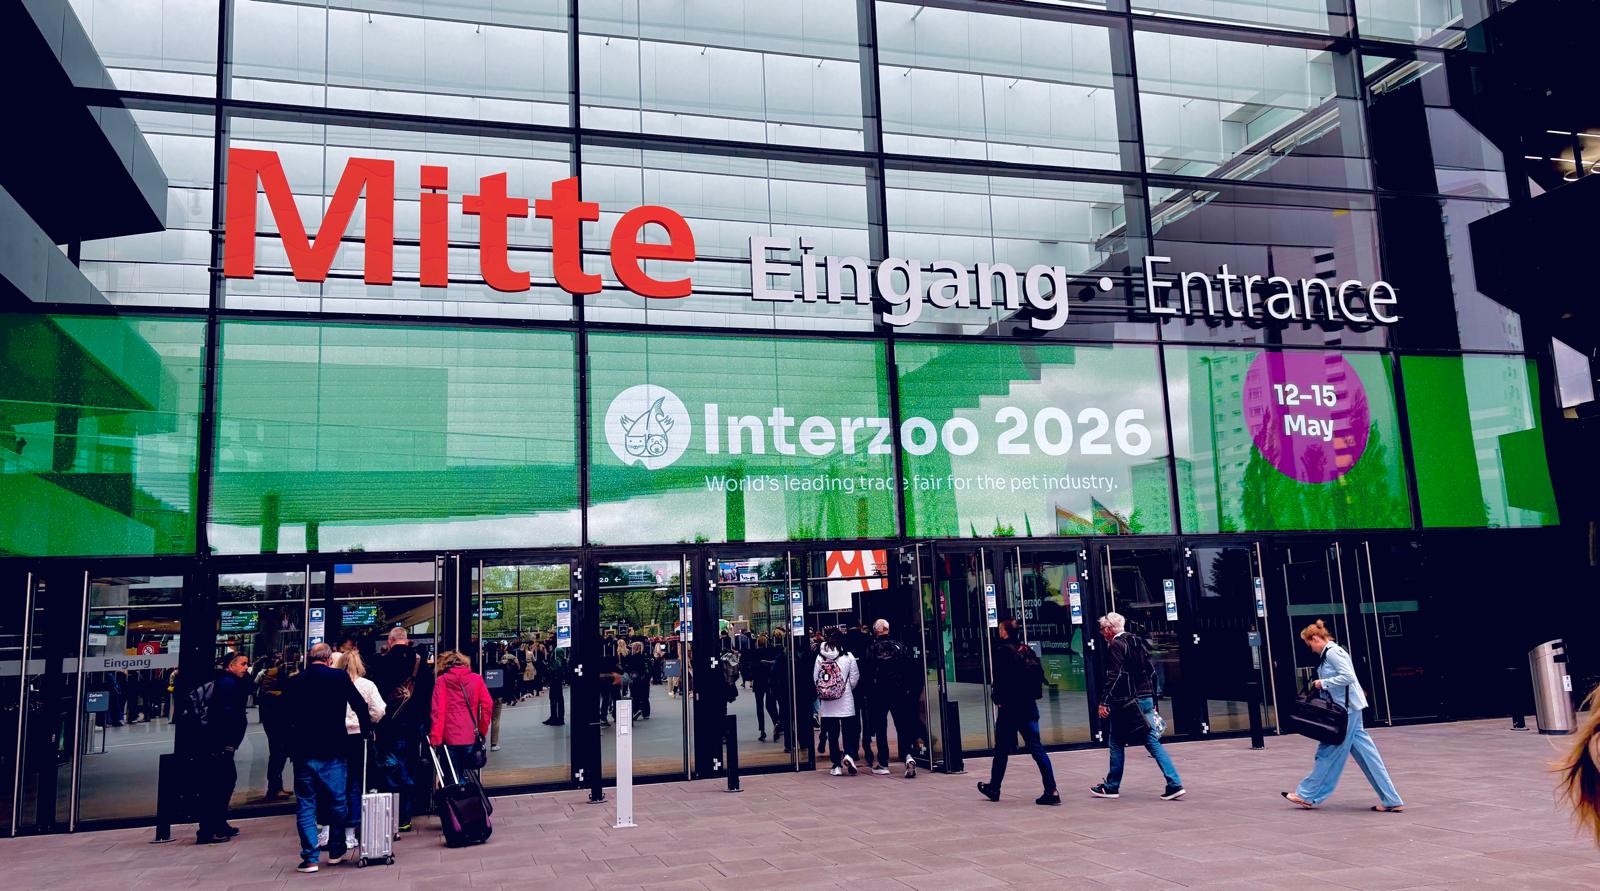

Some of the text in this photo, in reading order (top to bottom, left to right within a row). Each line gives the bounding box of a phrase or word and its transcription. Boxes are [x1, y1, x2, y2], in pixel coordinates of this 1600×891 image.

[223, 147, 696, 299] Mitte
[749, 236, 1069, 330] Eingang
[1143, 255, 1399, 323] Entrance
[704, 403, 1151, 456] Interzoo 2026
[1283, 414, 1334, 442] May
[705, 475, 779, 492] World's
[784, 475, 855, 494] leading
[913, 474, 942, 490] fair
[947, 474, 973, 490] for
[977, 474, 1006, 490] the
[1010, 476, 1039, 493] pet
[1042, 473, 1118, 493] industry.
[103, 658, 151, 668] Eingang
